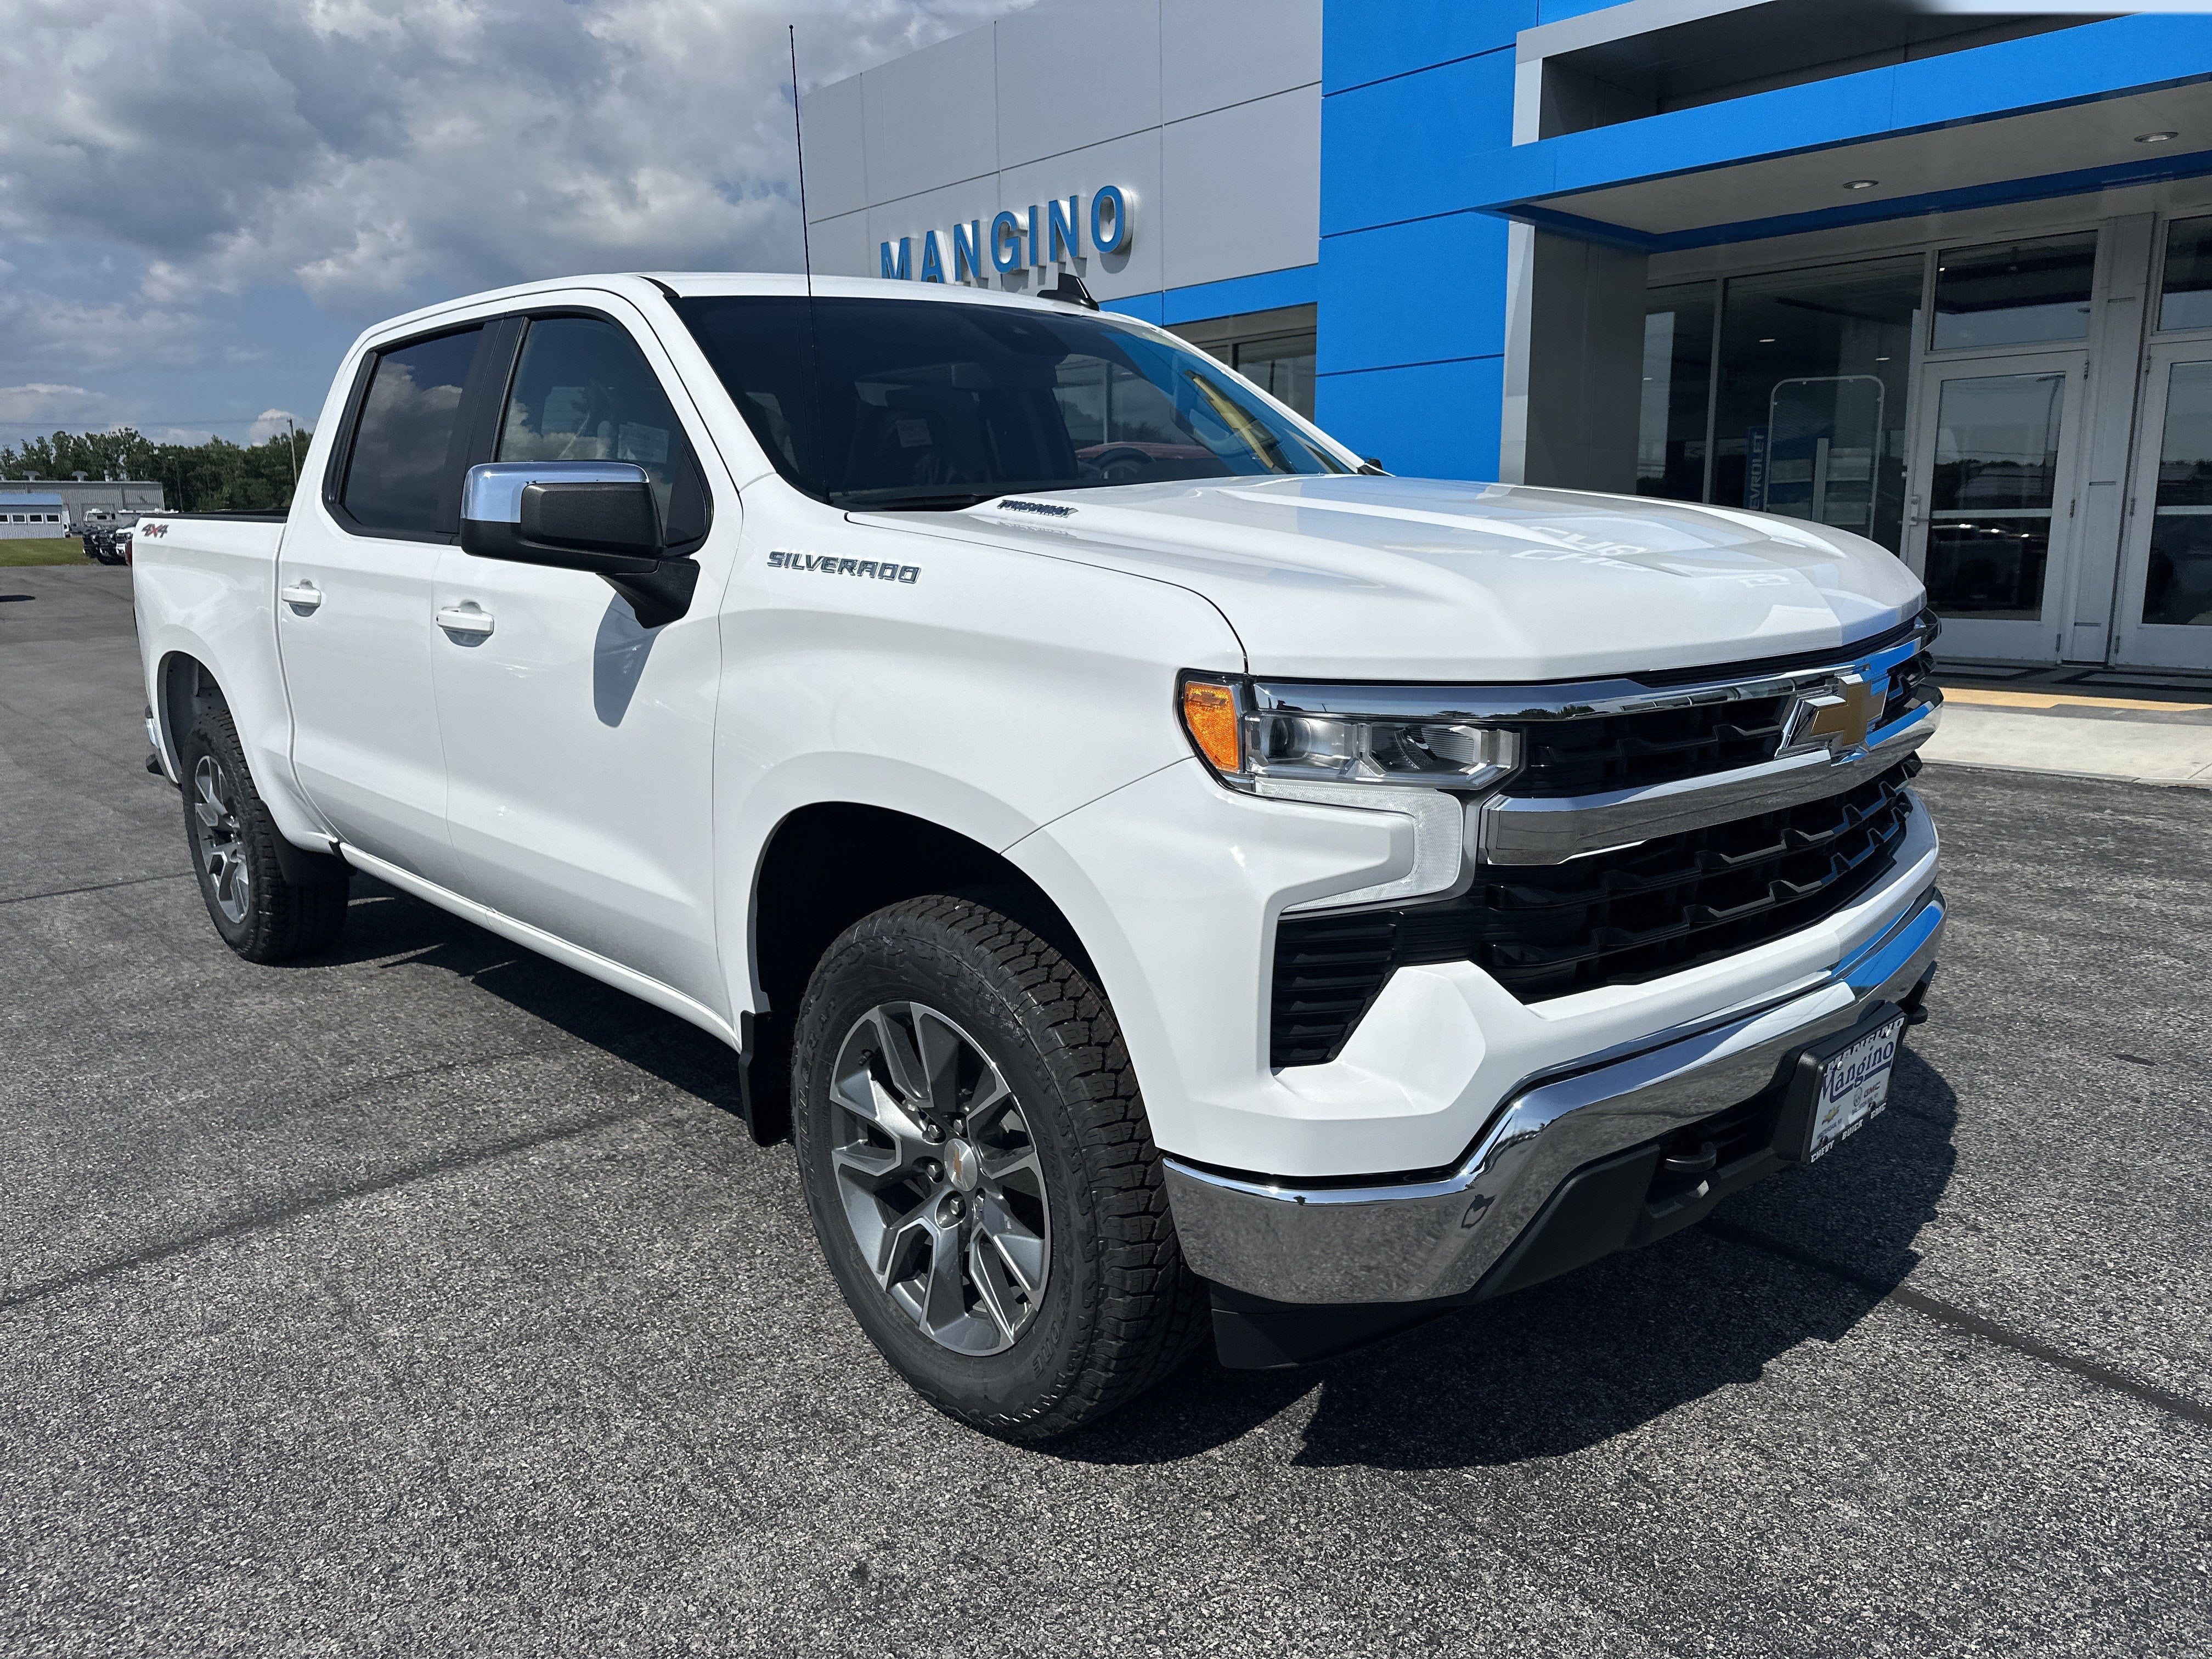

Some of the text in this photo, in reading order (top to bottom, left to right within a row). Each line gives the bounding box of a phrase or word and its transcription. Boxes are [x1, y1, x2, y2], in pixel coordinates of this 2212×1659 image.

[881, 185, 1132, 284] MANGINO
[767, 550, 922, 584] SILVERADO
[1822, 1041, 1894, 1102] Mangino
[1811, 1140, 1835, 1163] CHEVY
[1842, 1119, 1864, 1140] BUICK
[1870, 1102, 1887, 1119] GMC
